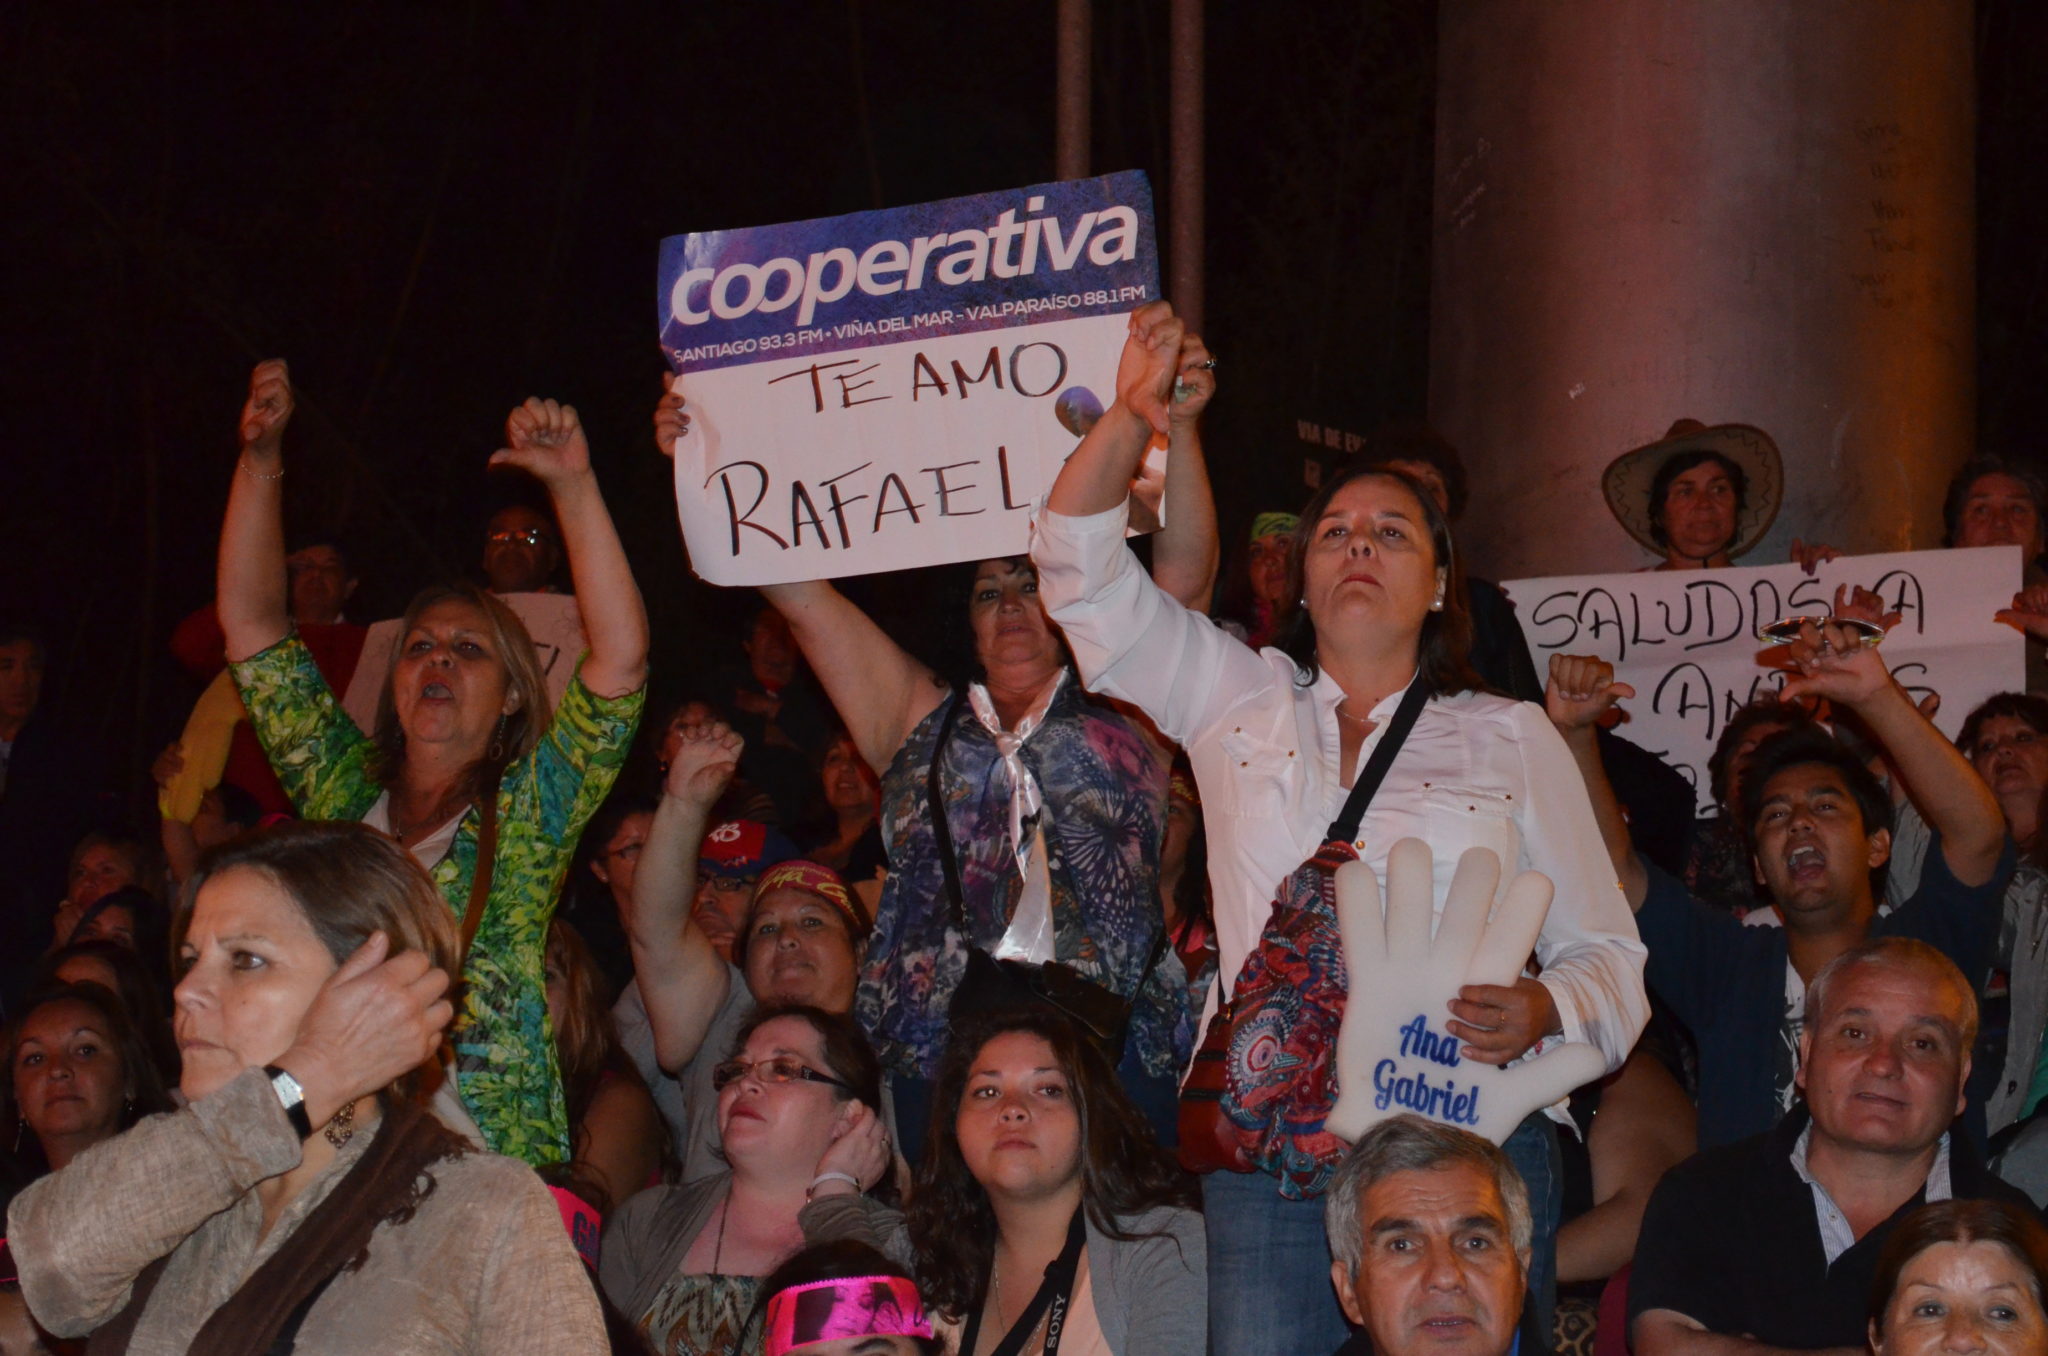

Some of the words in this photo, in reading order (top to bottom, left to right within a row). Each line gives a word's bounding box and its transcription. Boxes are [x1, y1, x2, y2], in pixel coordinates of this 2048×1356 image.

[670, 196, 1139, 327] cooperativa
[674, 338, 757, 363] SANTIAGO
[760, 333, 796, 350] 93.3
[800, 329, 824, 345] FM
[833, 319, 877, 340] VIÑA
[879, 317, 911, 334] DEL
[914, 310, 954, 328] MAR
[966, 293, 1081, 322] VALPARAÍSO
[1084, 289, 1119, 306] 88.1
[1120, 285, 1147, 302] FM
[768, 359, 893, 413] TE
[913, 342, 1068, 402] AMO
[704, 445, 1030, 556] RAFAEL
[1872, 570, 1924, 635] A
[1400, 1014, 1461, 1068] Ana
[1373, 1059, 1481, 1126] Gabriel
[1046, 1292, 1067, 1349] SONY
